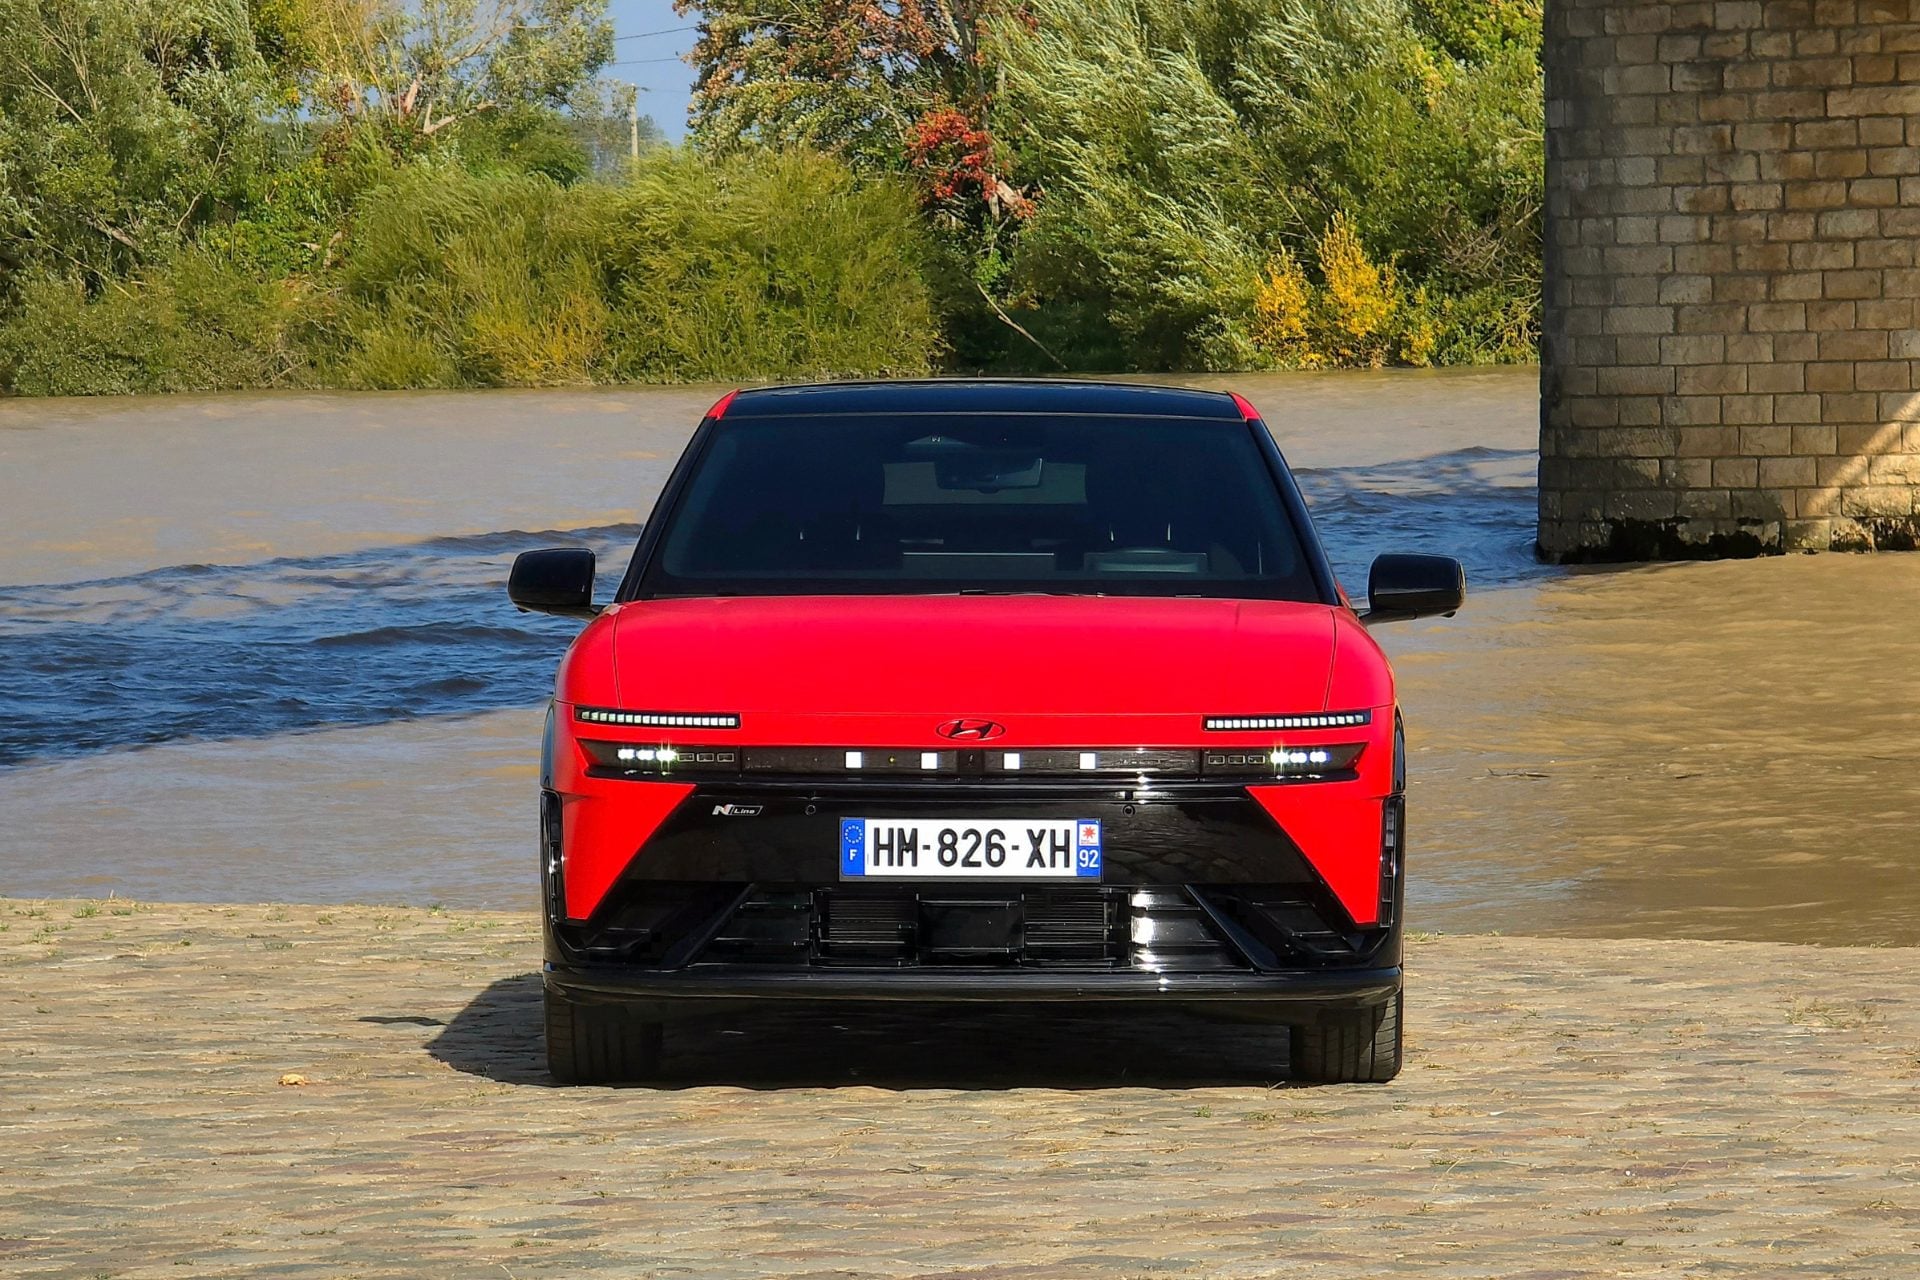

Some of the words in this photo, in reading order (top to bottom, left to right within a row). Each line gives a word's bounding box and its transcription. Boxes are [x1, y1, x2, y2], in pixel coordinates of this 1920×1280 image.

[712, 804, 733, 815] N
[849, 848, 858, 861] F
[873, 827, 1070, 868] HM-826-XH
[1079, 849, 1099, 868] 92
